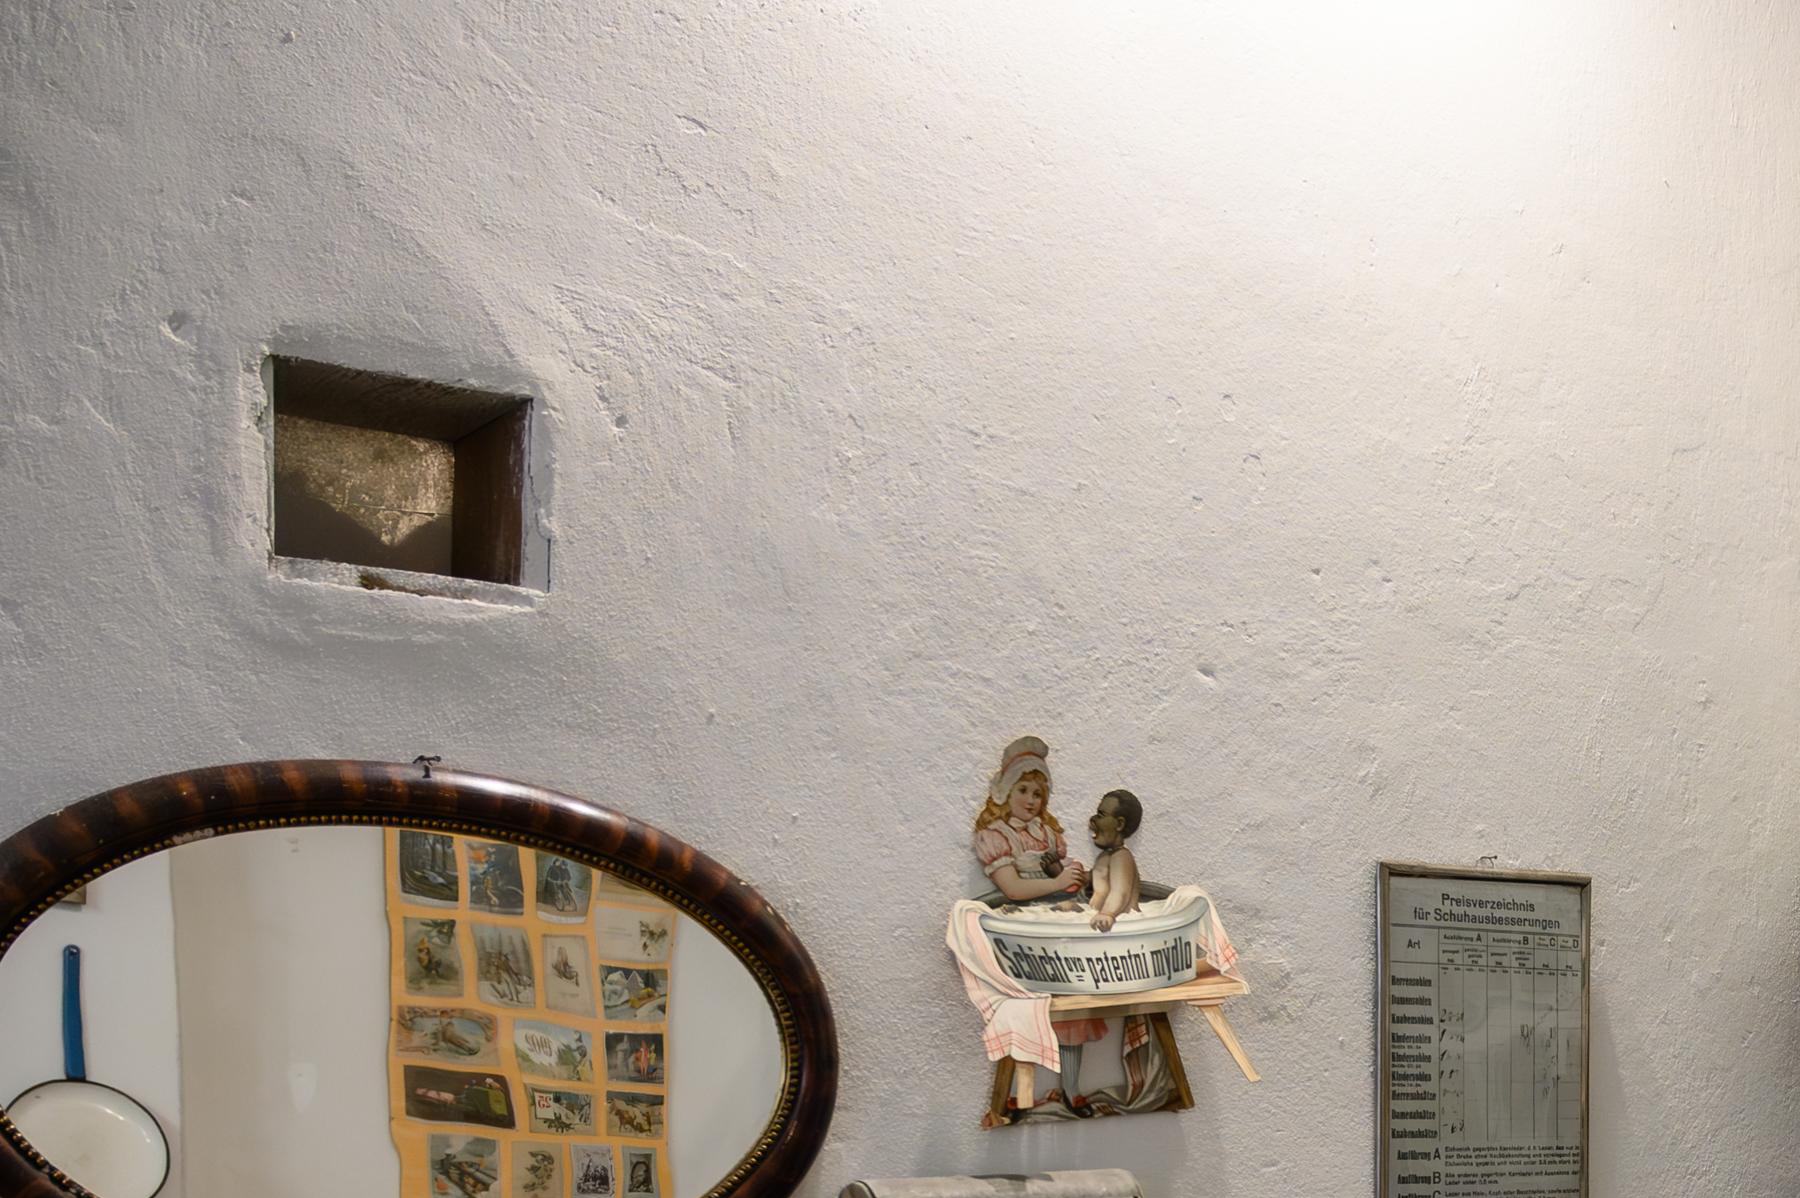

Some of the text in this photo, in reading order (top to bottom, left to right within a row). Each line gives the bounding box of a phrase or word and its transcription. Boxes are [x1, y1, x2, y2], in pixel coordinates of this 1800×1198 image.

[1441, 893, 1536, 914] Preisverzeichnis
[1413, 907, 1561, 931] für Schuhausbesserungen
[1407, 938, 1421, 950] Art
[1476, 933, 1483, 943] A
[1522, 936, 1529, 946] B
[1150, 936, 1193, 981] mýdlo
[1433, 1147, 1442, 1161] A
[1433, 1171, 1442, 1185] B
